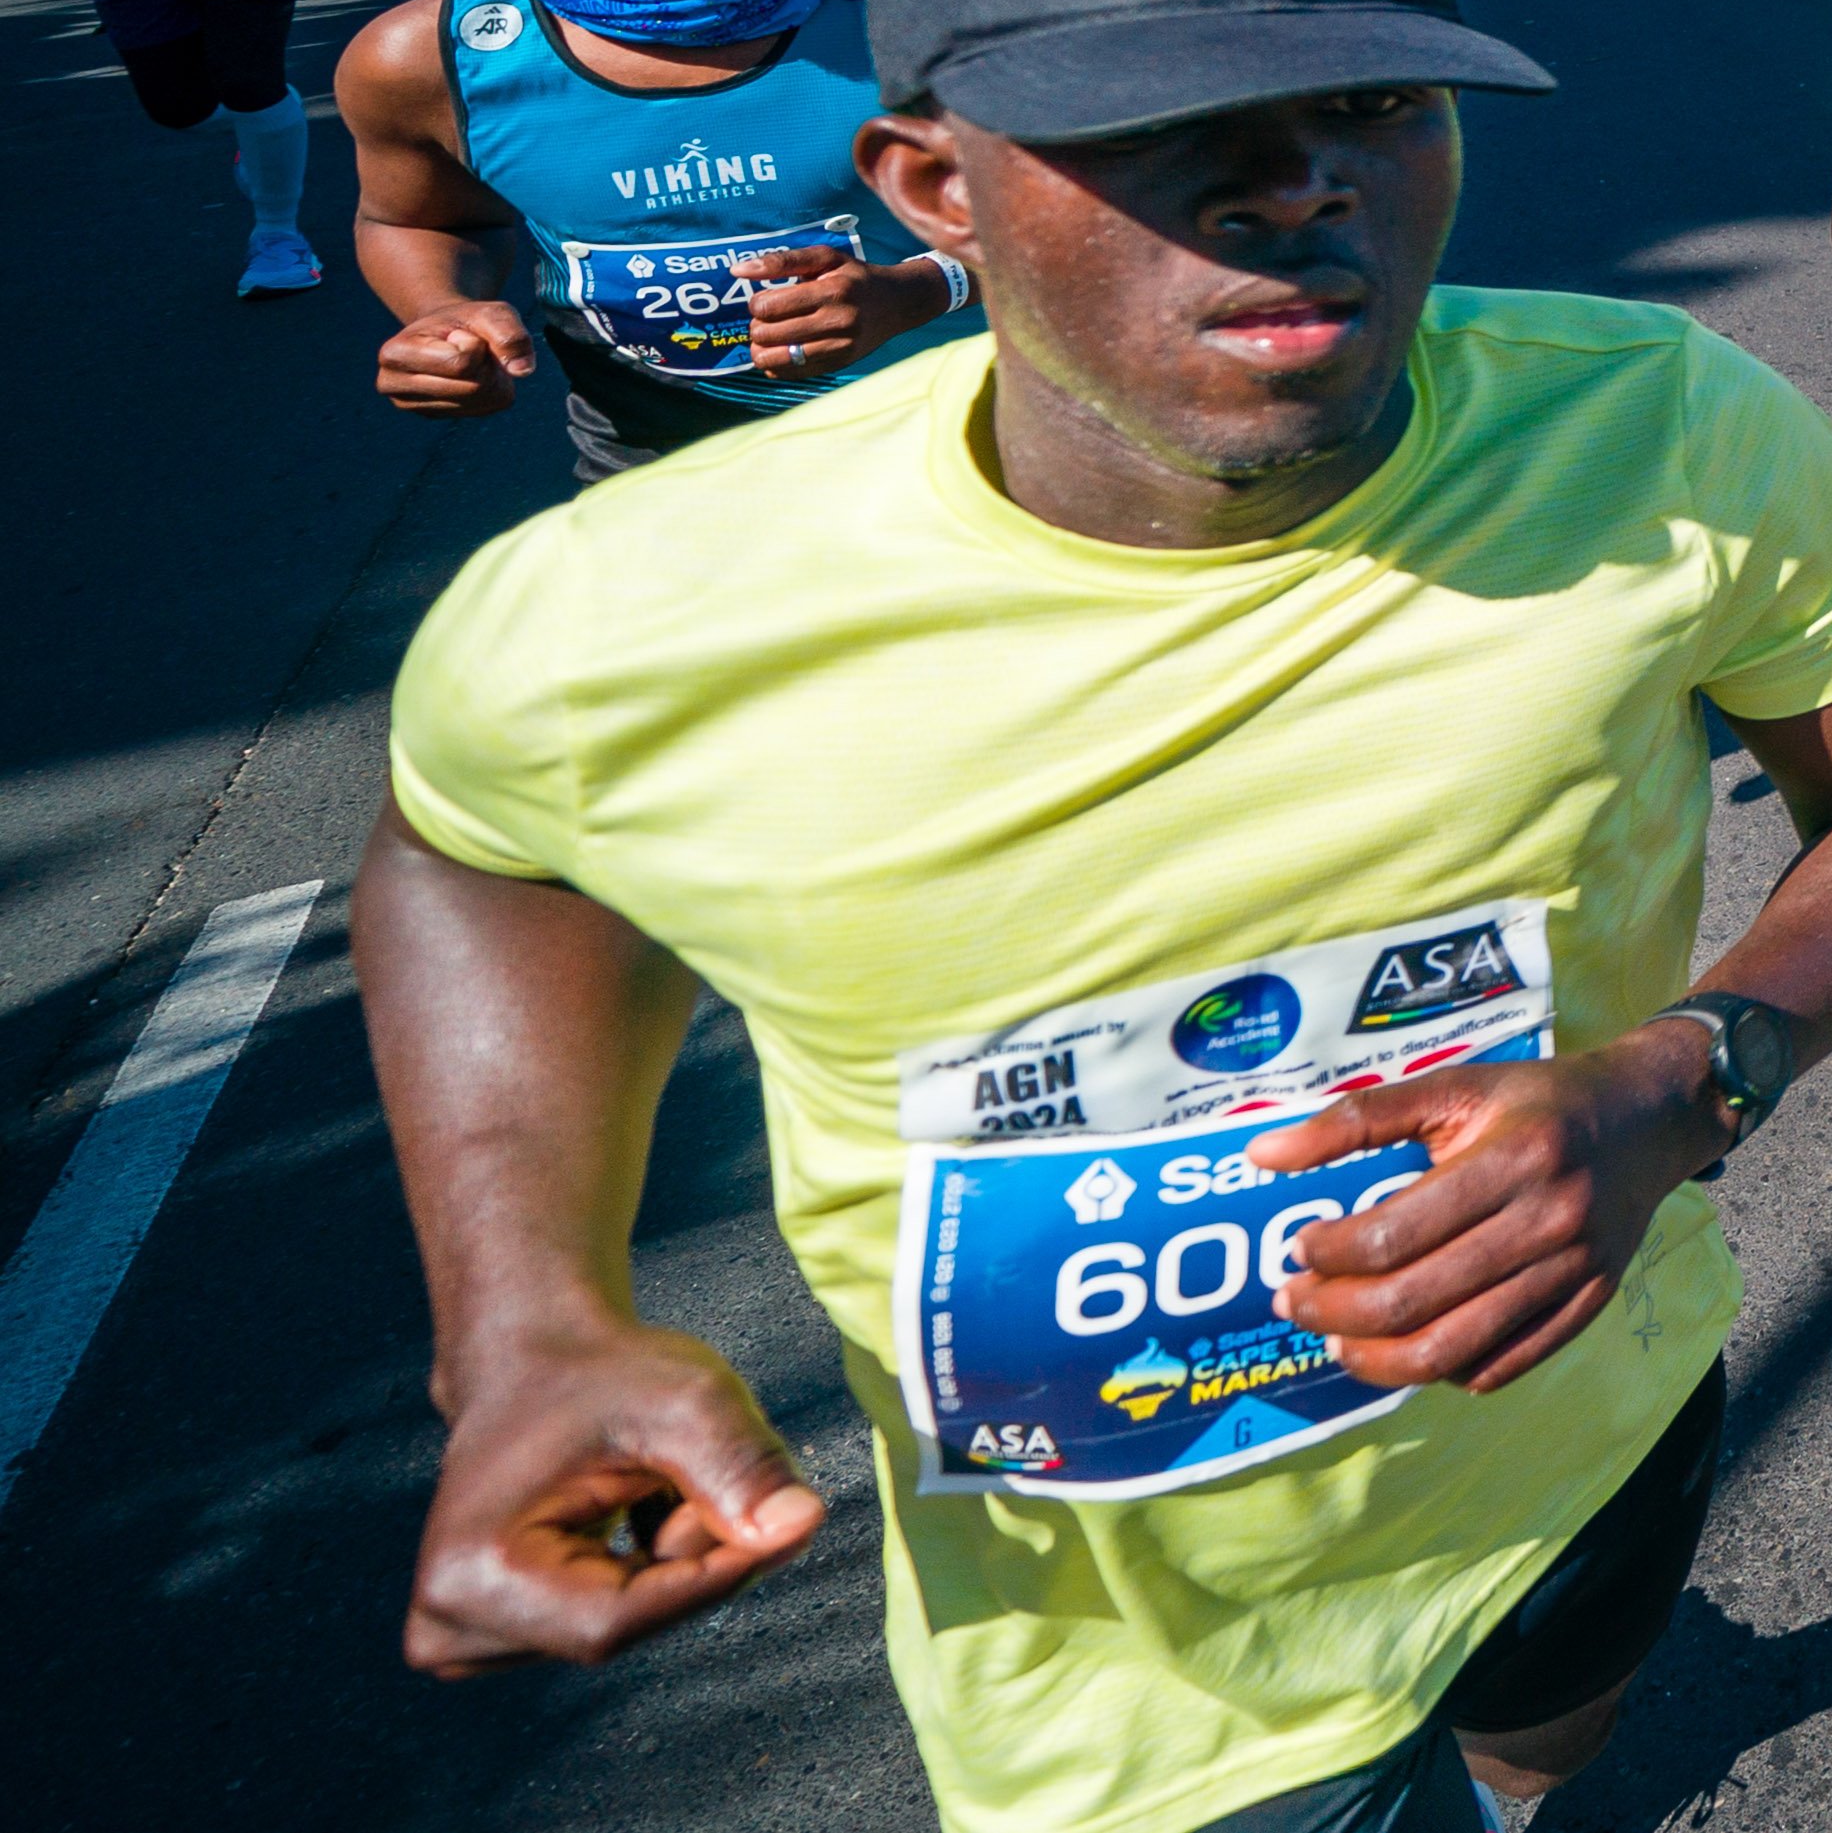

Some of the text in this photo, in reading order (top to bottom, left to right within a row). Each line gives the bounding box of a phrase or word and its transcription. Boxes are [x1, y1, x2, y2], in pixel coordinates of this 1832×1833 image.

[611, 152, 778, 200] VIKING
[646, 183, 756, 210] ATHLETICS
[1370, 932, 1502, 998] ASA
[972, 1049, 1078, 1112] AGN
[1181, 1089, 1235, 1120] logos
[1303, 1071, 1331, 1090] will
[1333, 1055, 1371, 1079] lead
[1377, 1046, 1396, 1063] to
[1400, 1005, 1527, 1057] disqualification
[1054, 1168, 1426, 1337] 606
[1189, 1347, 1338, 1407] MARATH
[1191, 1336, 1281, 1381] CAPE
[968, 1423, 1058, 1455] ASA
[1233, 1416, 1253, 1450] G
